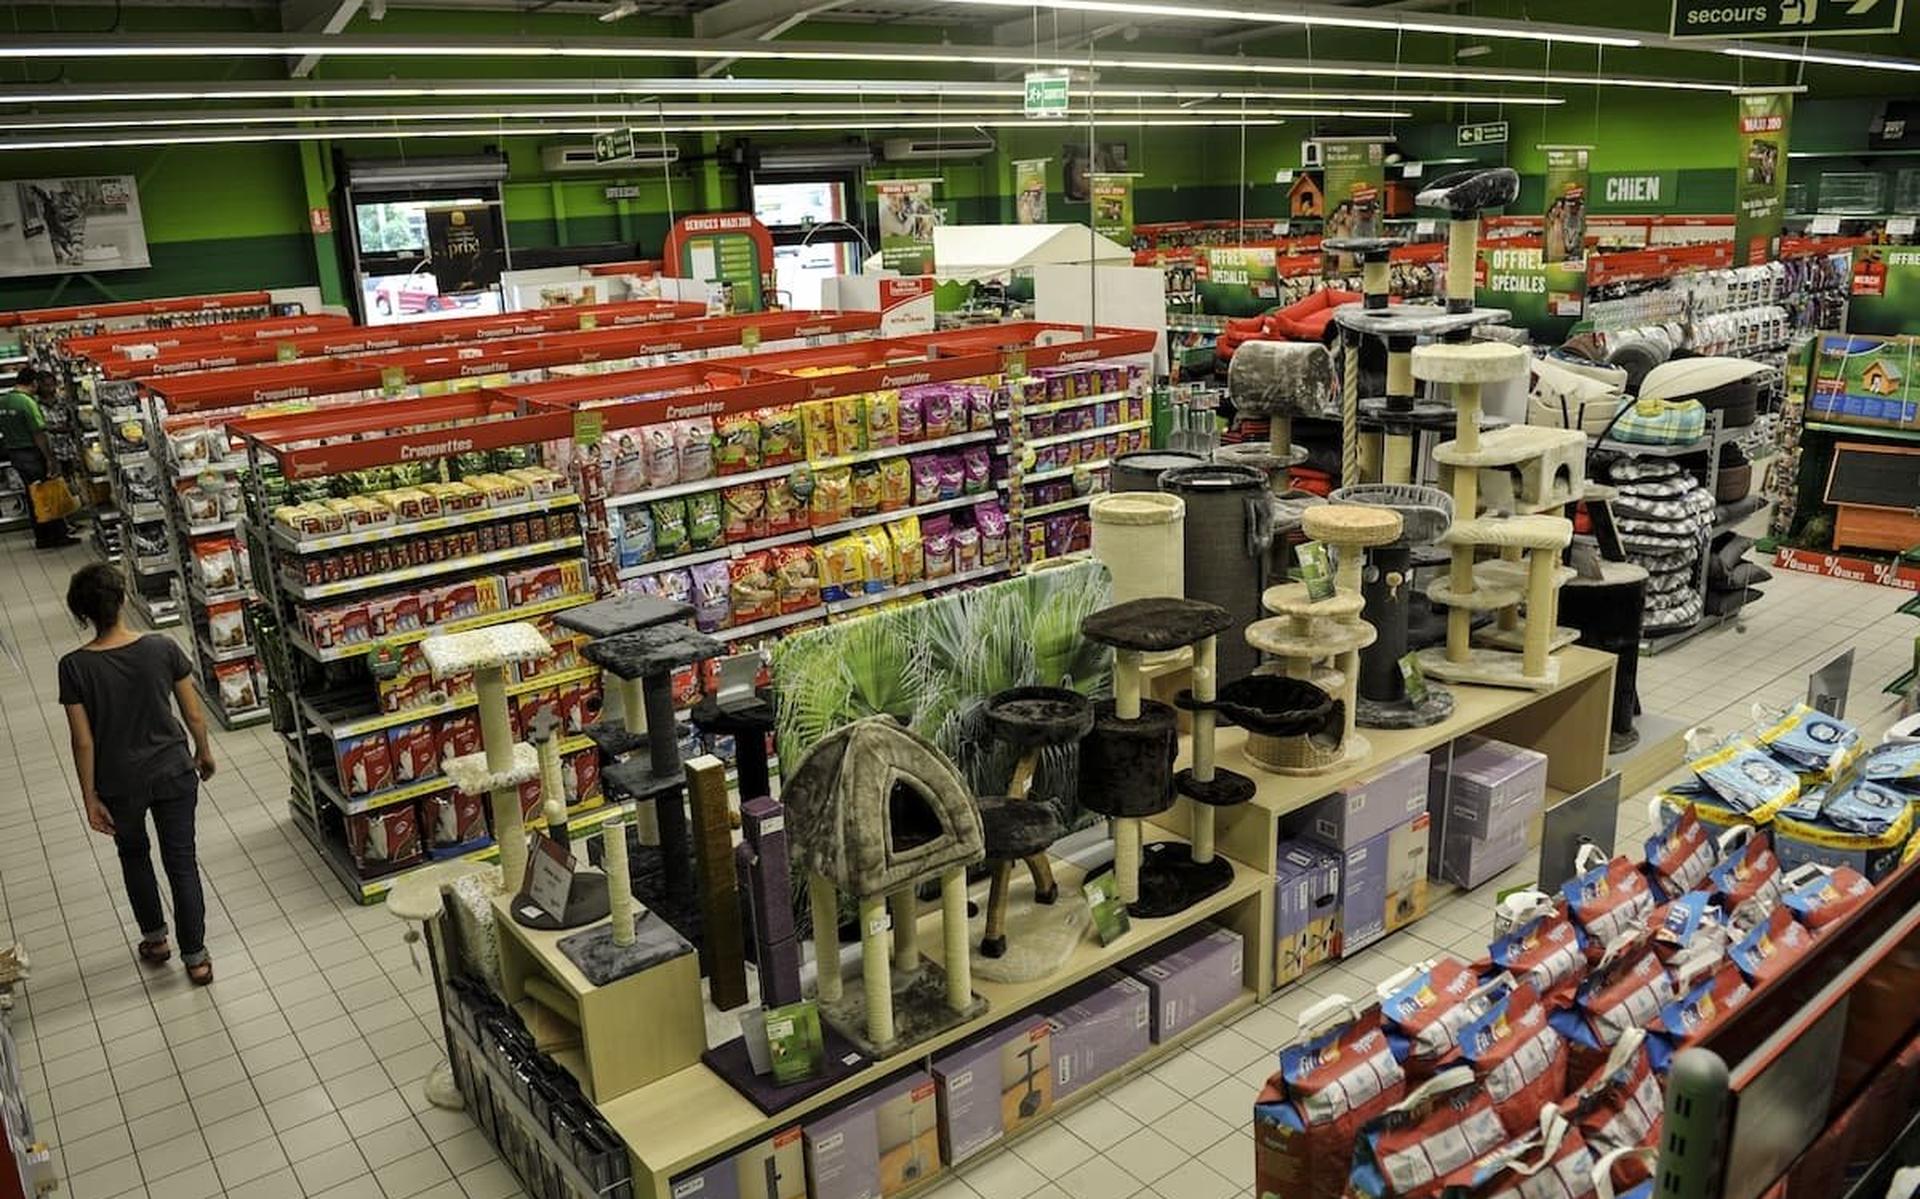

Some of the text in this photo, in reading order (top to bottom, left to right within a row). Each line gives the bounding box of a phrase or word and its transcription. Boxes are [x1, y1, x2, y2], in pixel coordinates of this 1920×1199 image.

[1687, 5, 1767, 24] secours
[684, 218, 719, 231] SERVICES
[1491, 270, 1546, 293] SPÉCIALES
[640, 341, 682, 354] Croquettes
[461, 361, 508, 376] Croquettes
[881, 372, 930, 387] Croquettes
[254, 386, 309, 402] Croquettes
[666, 400, 724, 419] Croquettes
[401, 439, 472, 459] Croquettes
